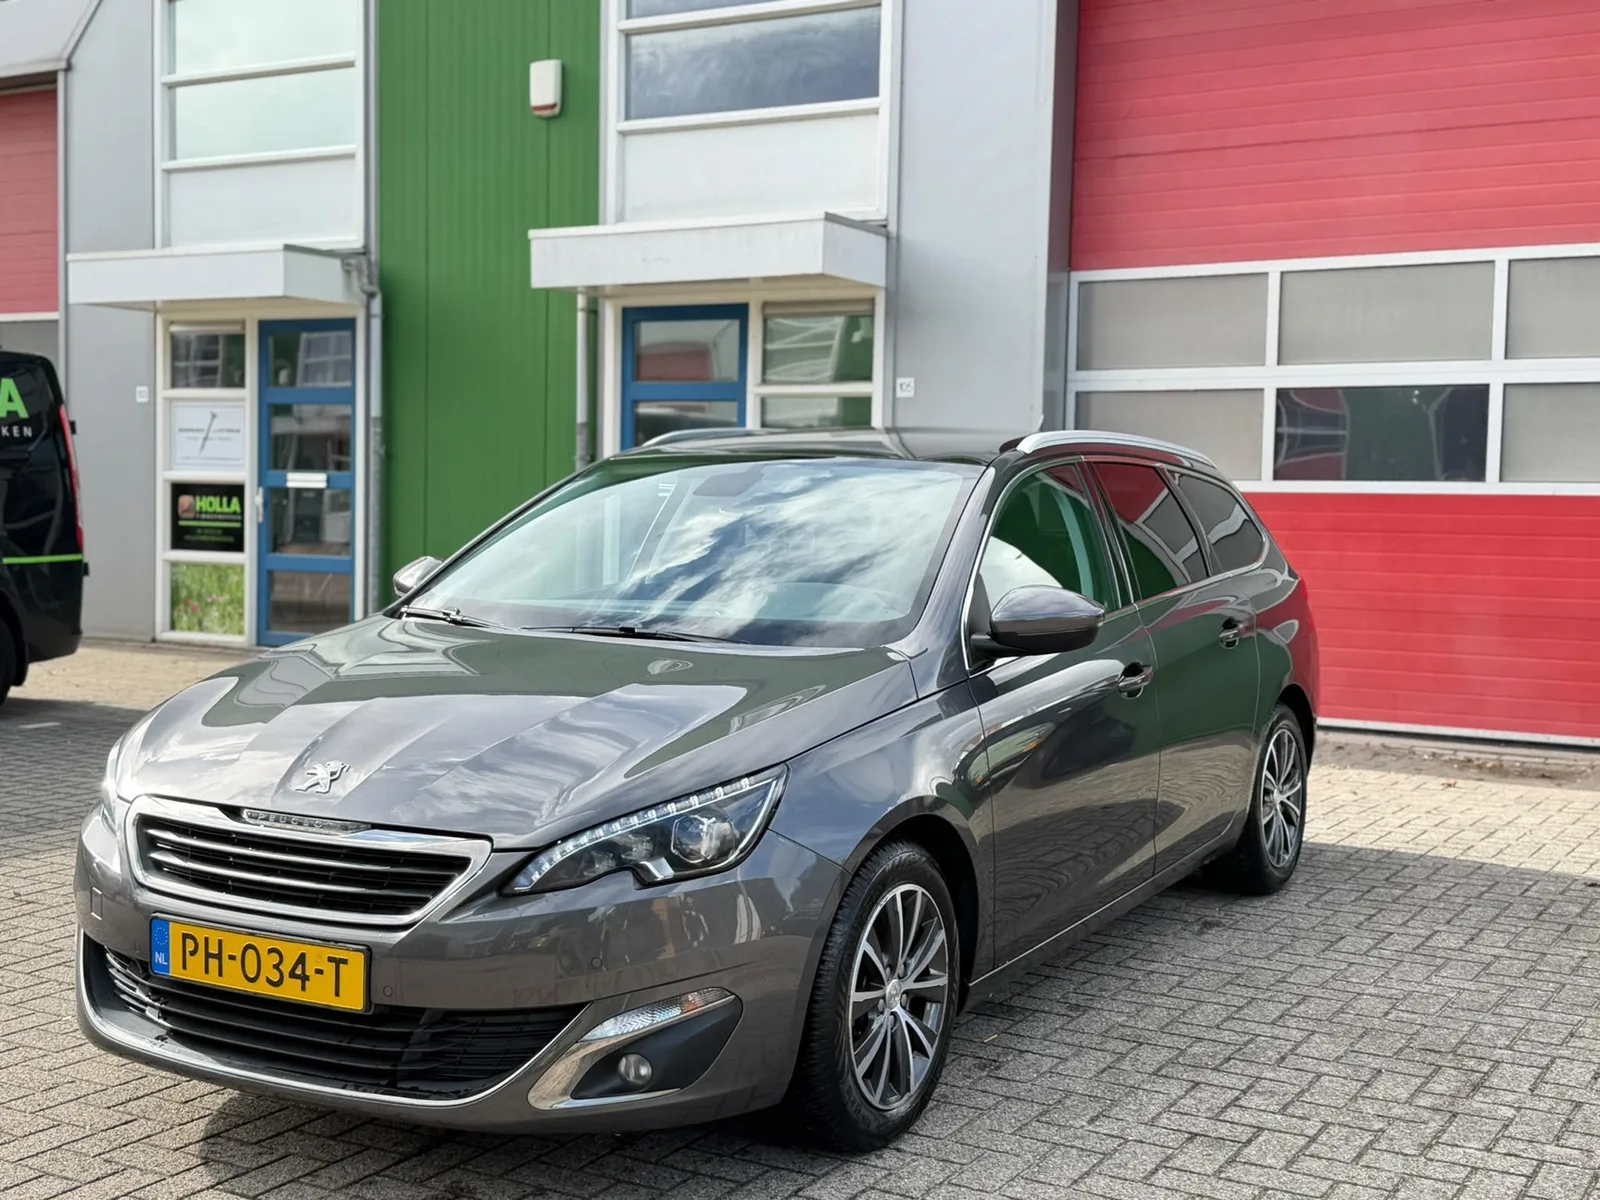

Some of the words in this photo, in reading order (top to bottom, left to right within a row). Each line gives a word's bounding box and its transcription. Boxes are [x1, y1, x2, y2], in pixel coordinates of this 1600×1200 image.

[195, 495, 241, 513] HOLLA
[154, 952, 168, 966] NL
[181, 932, 348, 997] PH-034-T
